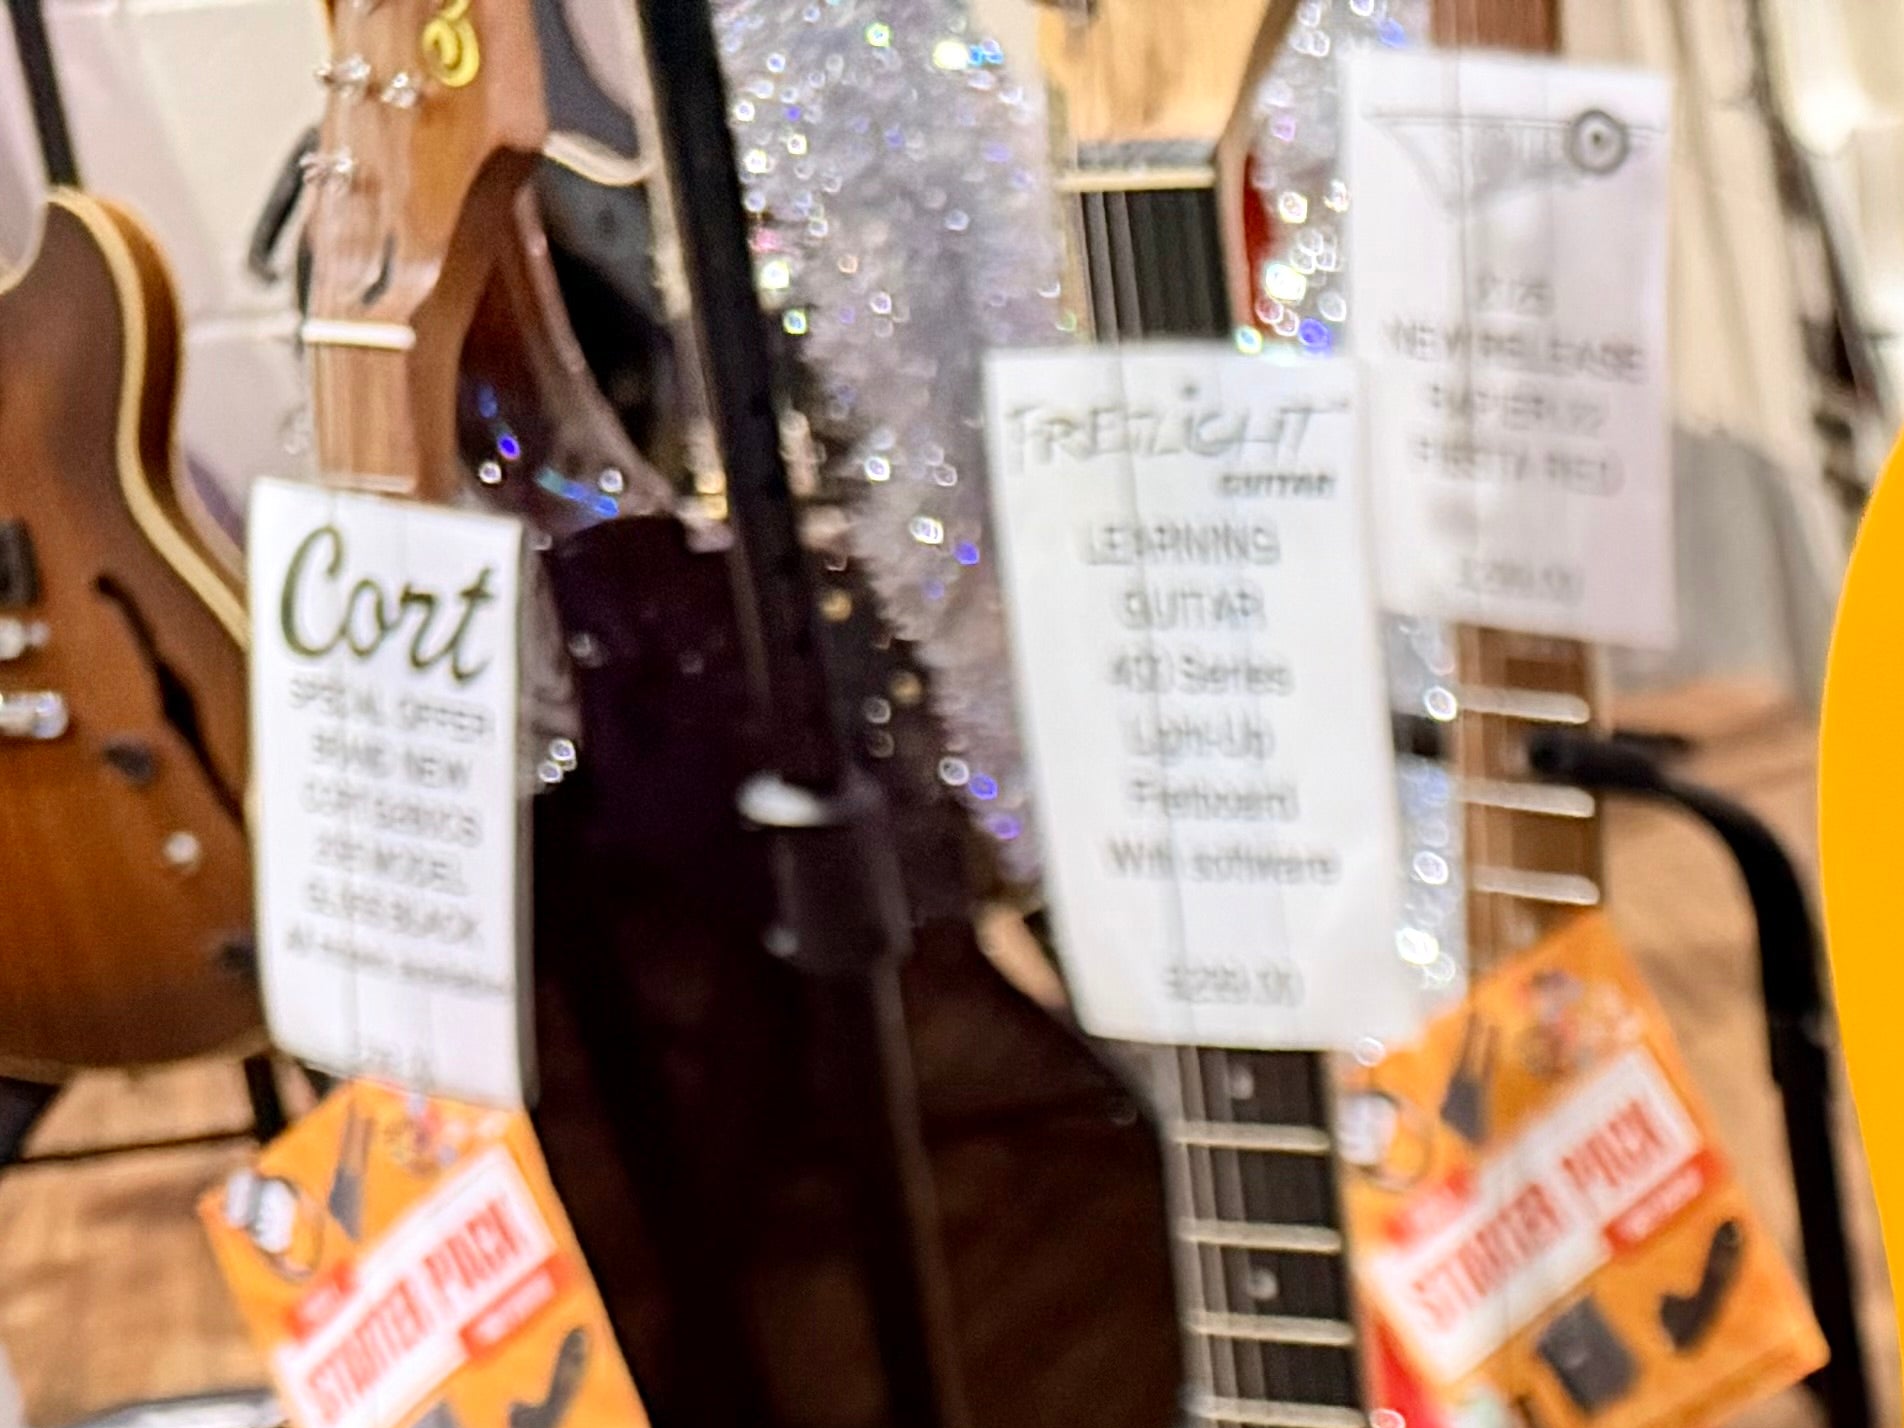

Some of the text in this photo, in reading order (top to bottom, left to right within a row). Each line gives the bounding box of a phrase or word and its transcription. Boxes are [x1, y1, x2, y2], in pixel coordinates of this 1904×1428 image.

[1084, 525, 1281, 566] LEARNING
[280, 524, 498, 683] Cort
[1121, 589, 1265, 631] GUITAR
[1180, 654, 1294, 696] Series
[288, 677, 497, 743] SPECIAL OFFER
[402, 748, 472, 791] NEW
[1191, 842, 1340, 885] software
[1409, 1183, 1564, 1327] STARTER
[1562, 1101, 1668, 1206] PACK
[306, 1278, 433, 1425] STARTER
[423, 1202, 526, 1317] PACK
